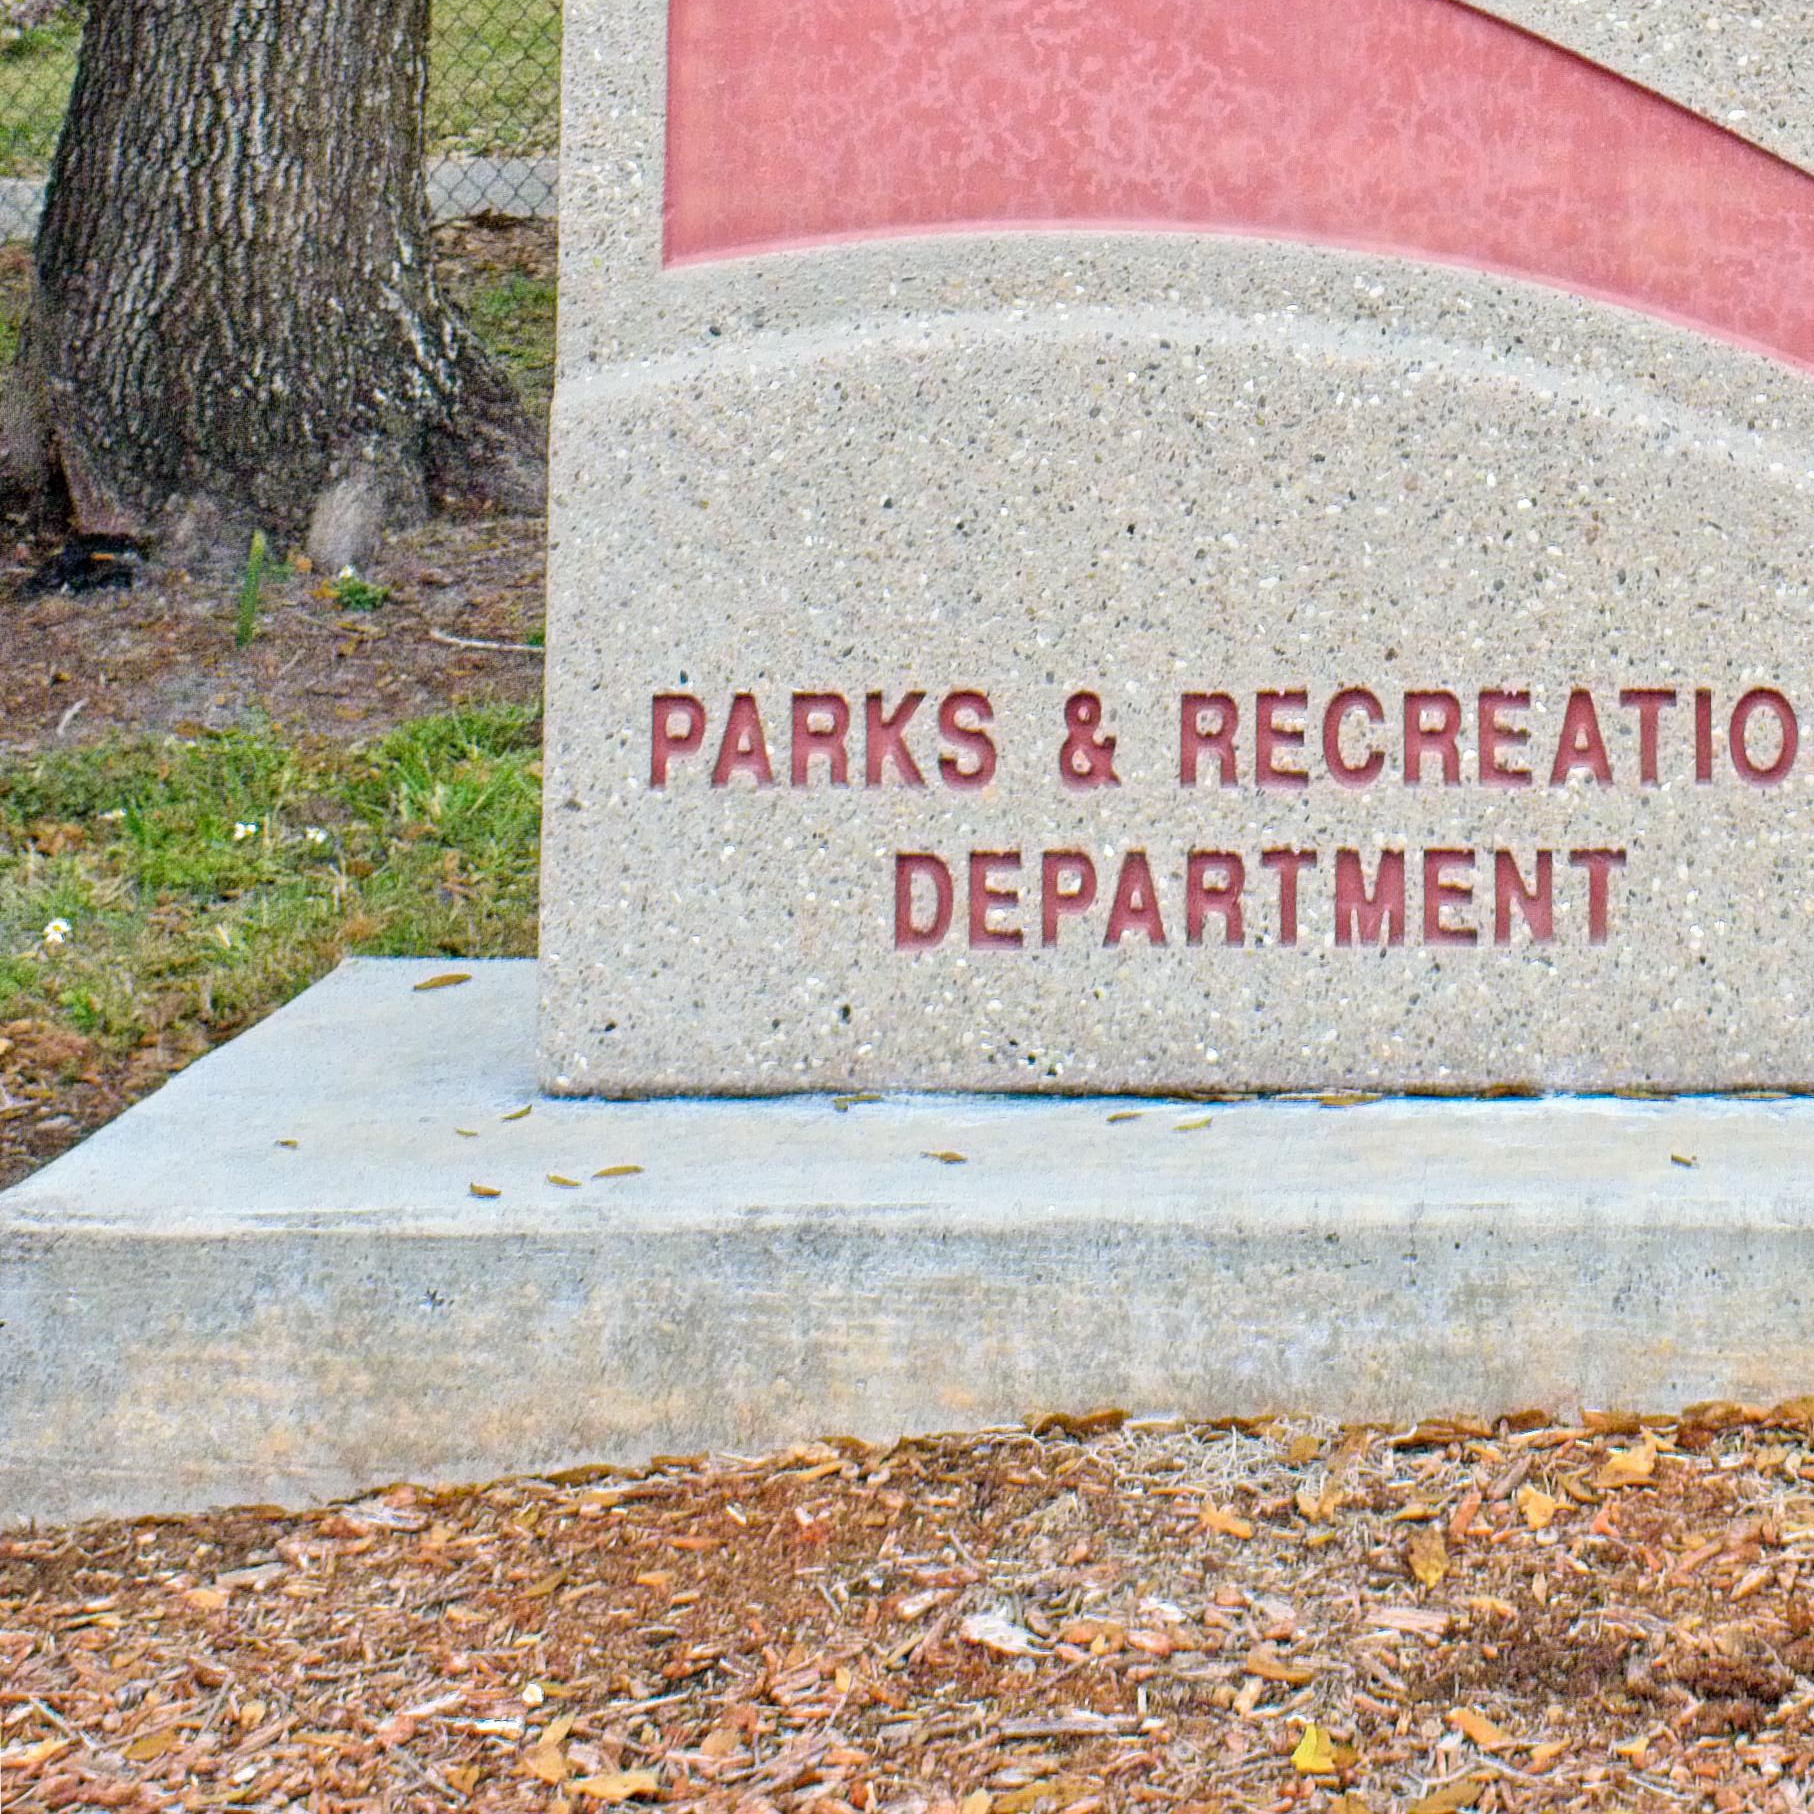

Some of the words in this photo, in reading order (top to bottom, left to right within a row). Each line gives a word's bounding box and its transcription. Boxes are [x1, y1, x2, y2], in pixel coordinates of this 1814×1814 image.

[652, 689, 997, 787] PARKS
[1061, 691, 1117, 786] &
[895, 847, 1626, 949] DEPARTMENT
